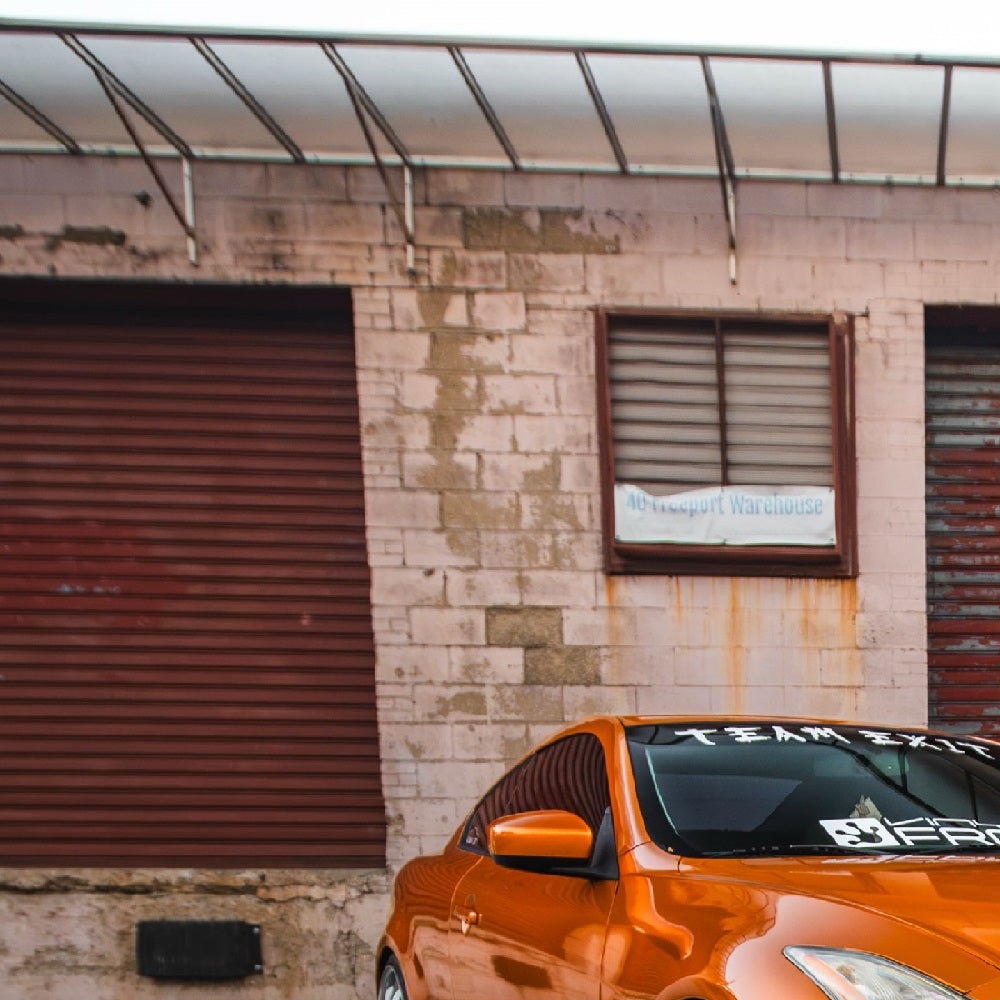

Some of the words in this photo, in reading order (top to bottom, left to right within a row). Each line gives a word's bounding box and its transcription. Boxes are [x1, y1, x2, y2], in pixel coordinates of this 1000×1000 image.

[730, 493, 824, 516] Warehouse
[674, 725, 851, 746] TEAM
[858, 730, 996, 760] EXIT
